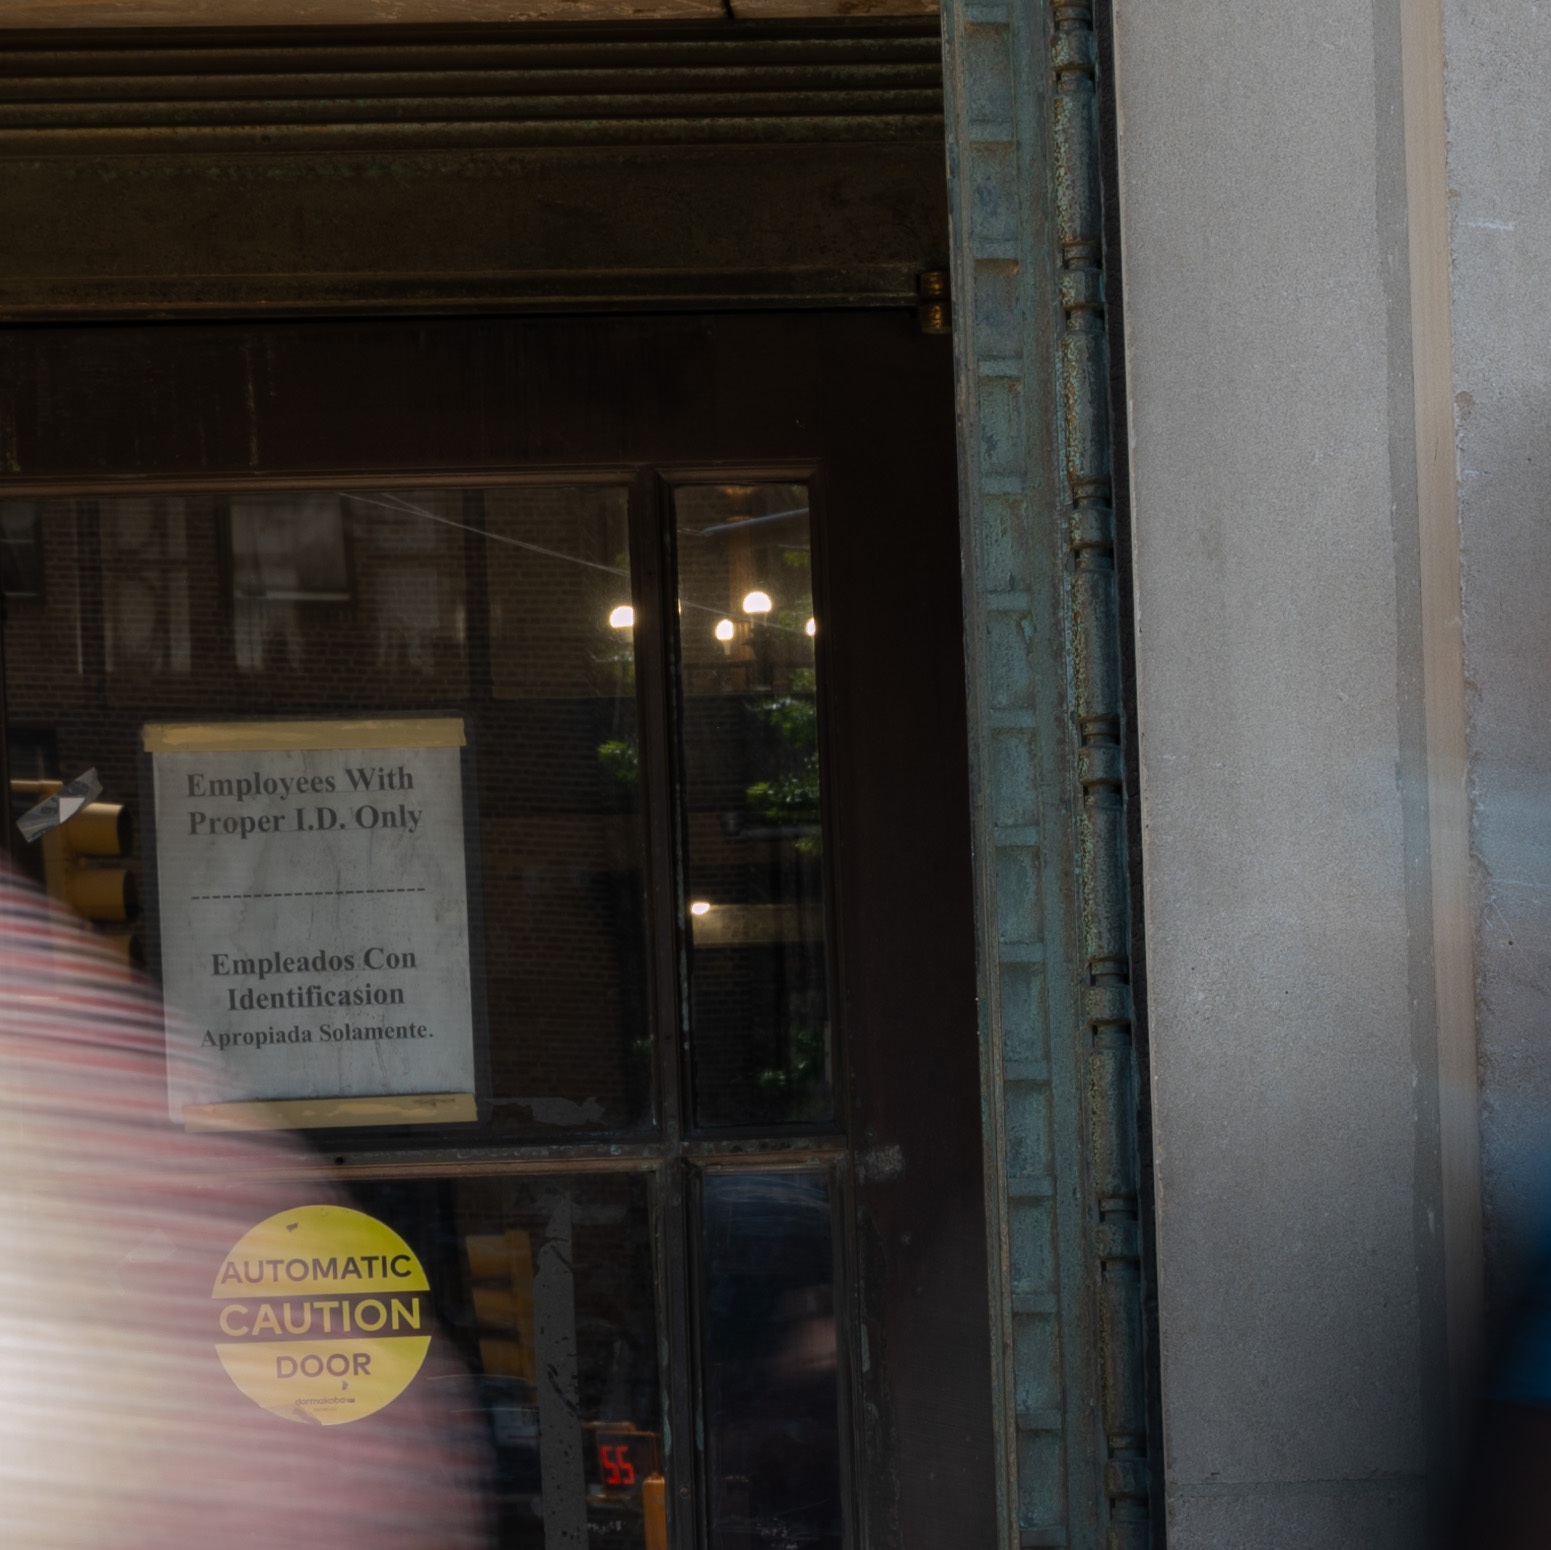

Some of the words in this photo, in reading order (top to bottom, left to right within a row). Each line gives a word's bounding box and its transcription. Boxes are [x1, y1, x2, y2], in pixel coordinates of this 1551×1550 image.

[187, 772, 336, 801] Employees
[345, 766, 414, 791] With
[188, 811, 286, 840] Proper
[296, 807, 346, 832] I.D.
[355, 804, 423, 834] Only
[212, 950, 355, 980] Empleados
[363, 947, 417, 971] Con
[227, 983, 405, 1011] Identificasion
[201, 1026, 313, 1050] Apropiada
[319, 1022, 434, 1042] Solamente.
[220, 1254, 412, 1285] AUTOMATIC
[219, 1297, 421, 1337] CAUTION
[276, 1353, 372, 1379] DOOR
